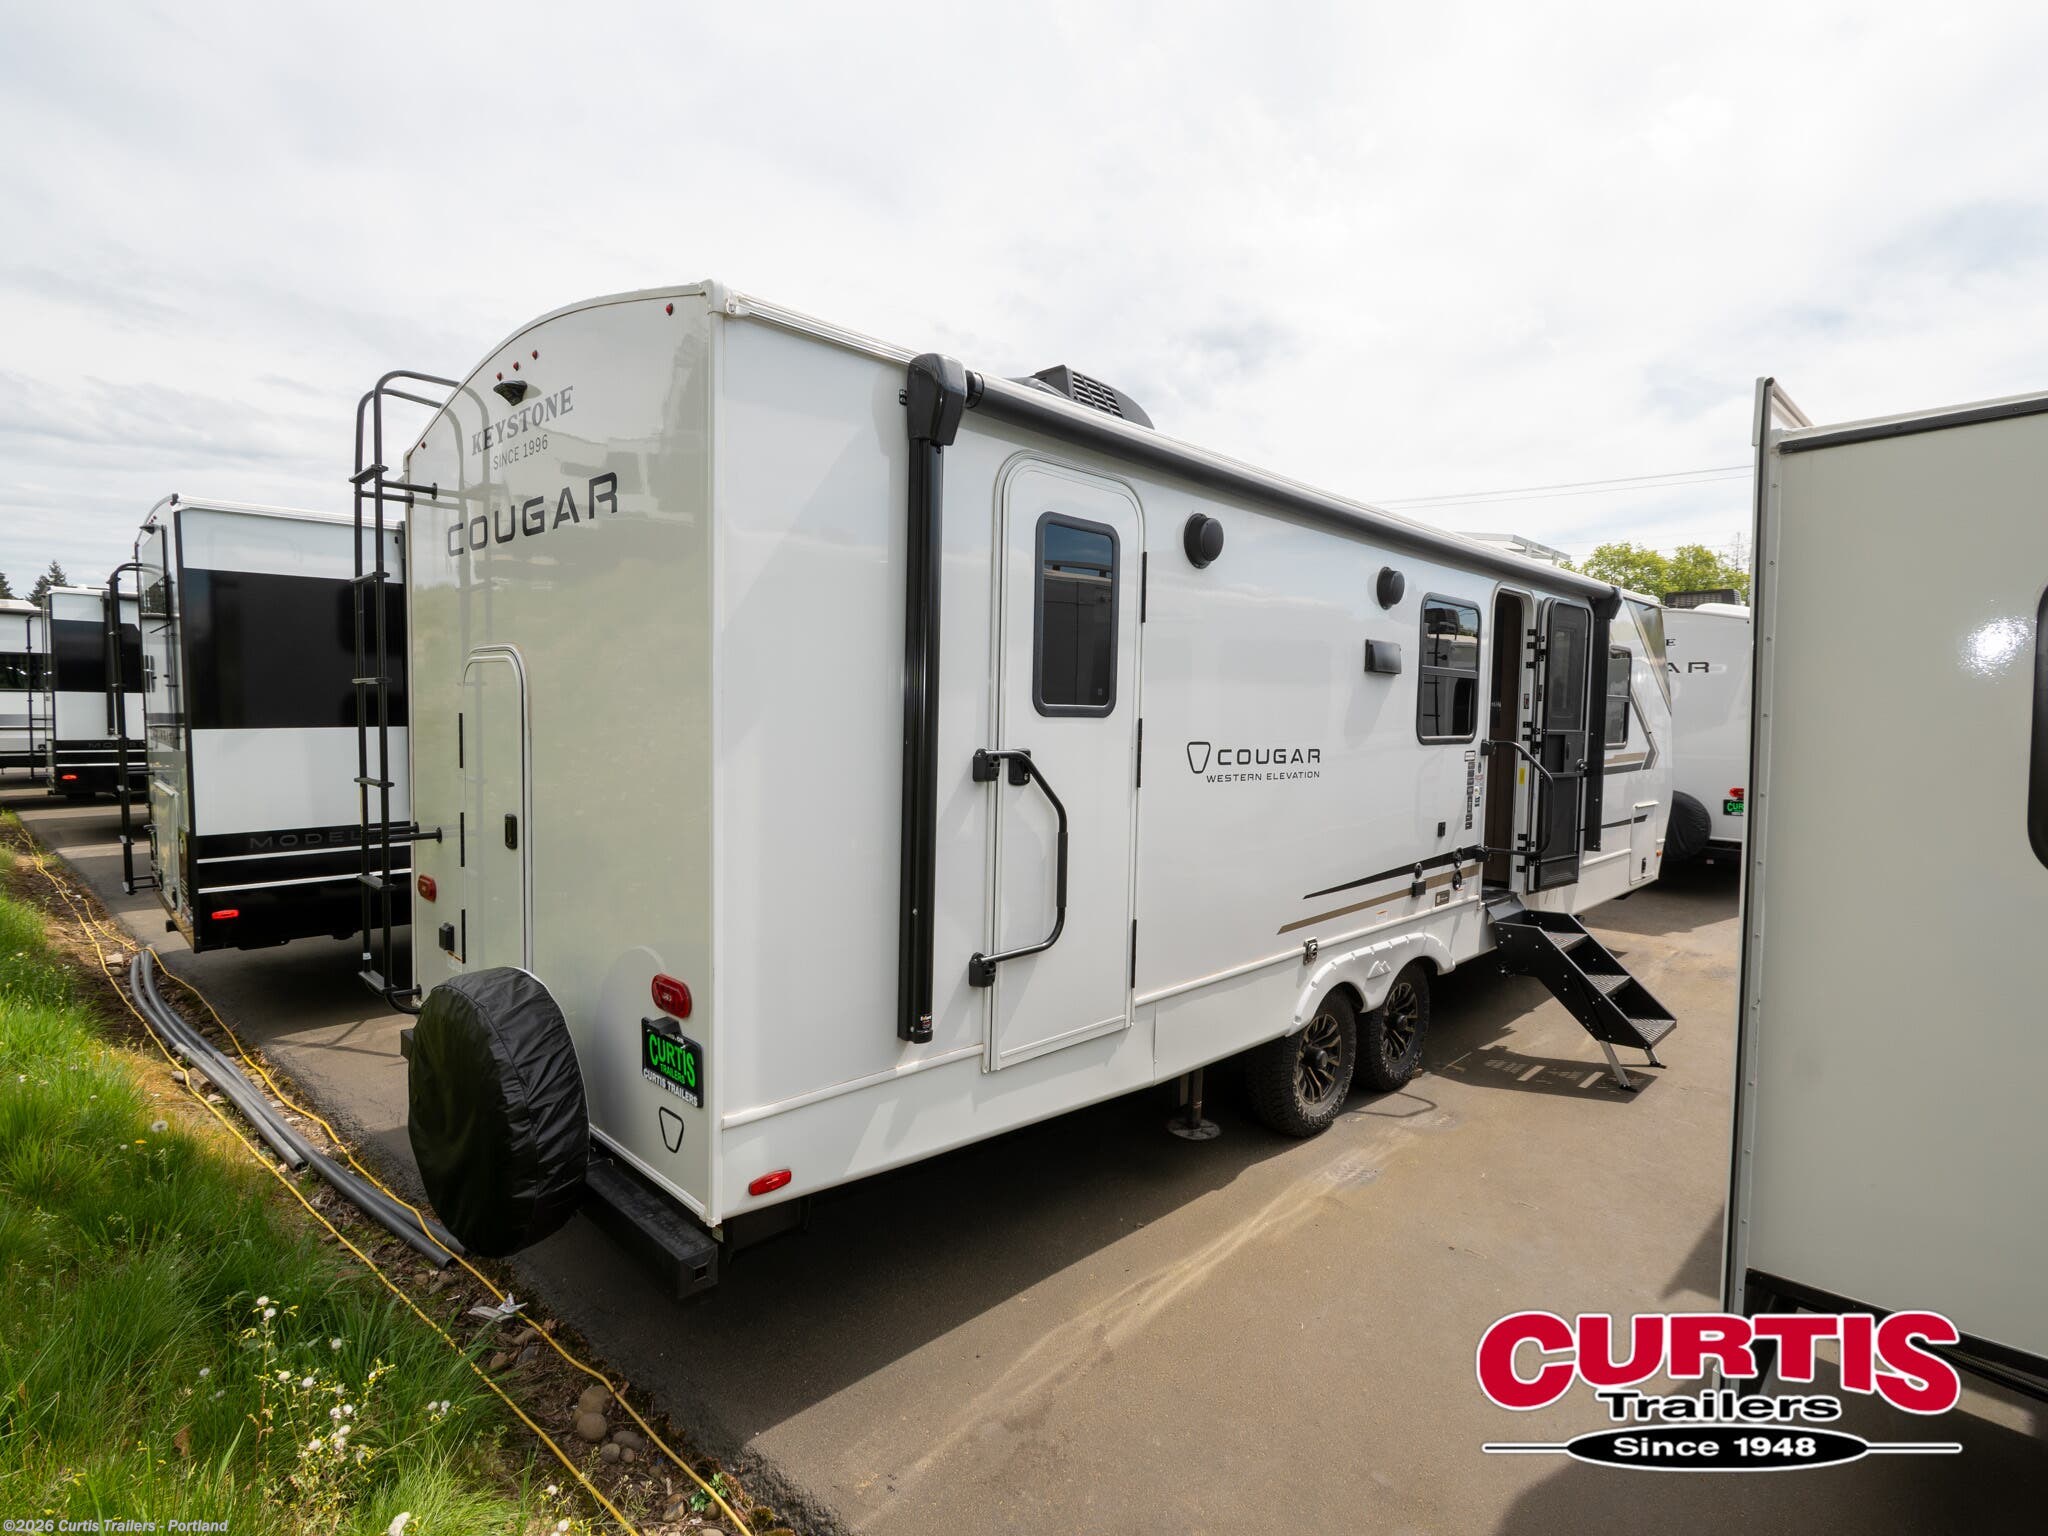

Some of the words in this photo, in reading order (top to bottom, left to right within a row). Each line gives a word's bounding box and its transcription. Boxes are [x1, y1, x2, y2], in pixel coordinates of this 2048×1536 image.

[471, 385, 574, 456] KEYSTONE
[493, 446, 519, 470] SINCE
[523, 433, 548, 458] 1996
[447, 472, 617, 557] COUGAR
[1217, 748, 1321, 766] COUGAR
[1206, 773, 1262, 783] WESTERN
[1266, 771, 1320, 781] ELEVATION
[649, 1033, 696, 1087] CURTIS
[660, 1063, 685, 1085] TRAILERS
[643, 1067, 667, 1088] CURTIS
[667, 1080, 698, 1106] TRAILERS
